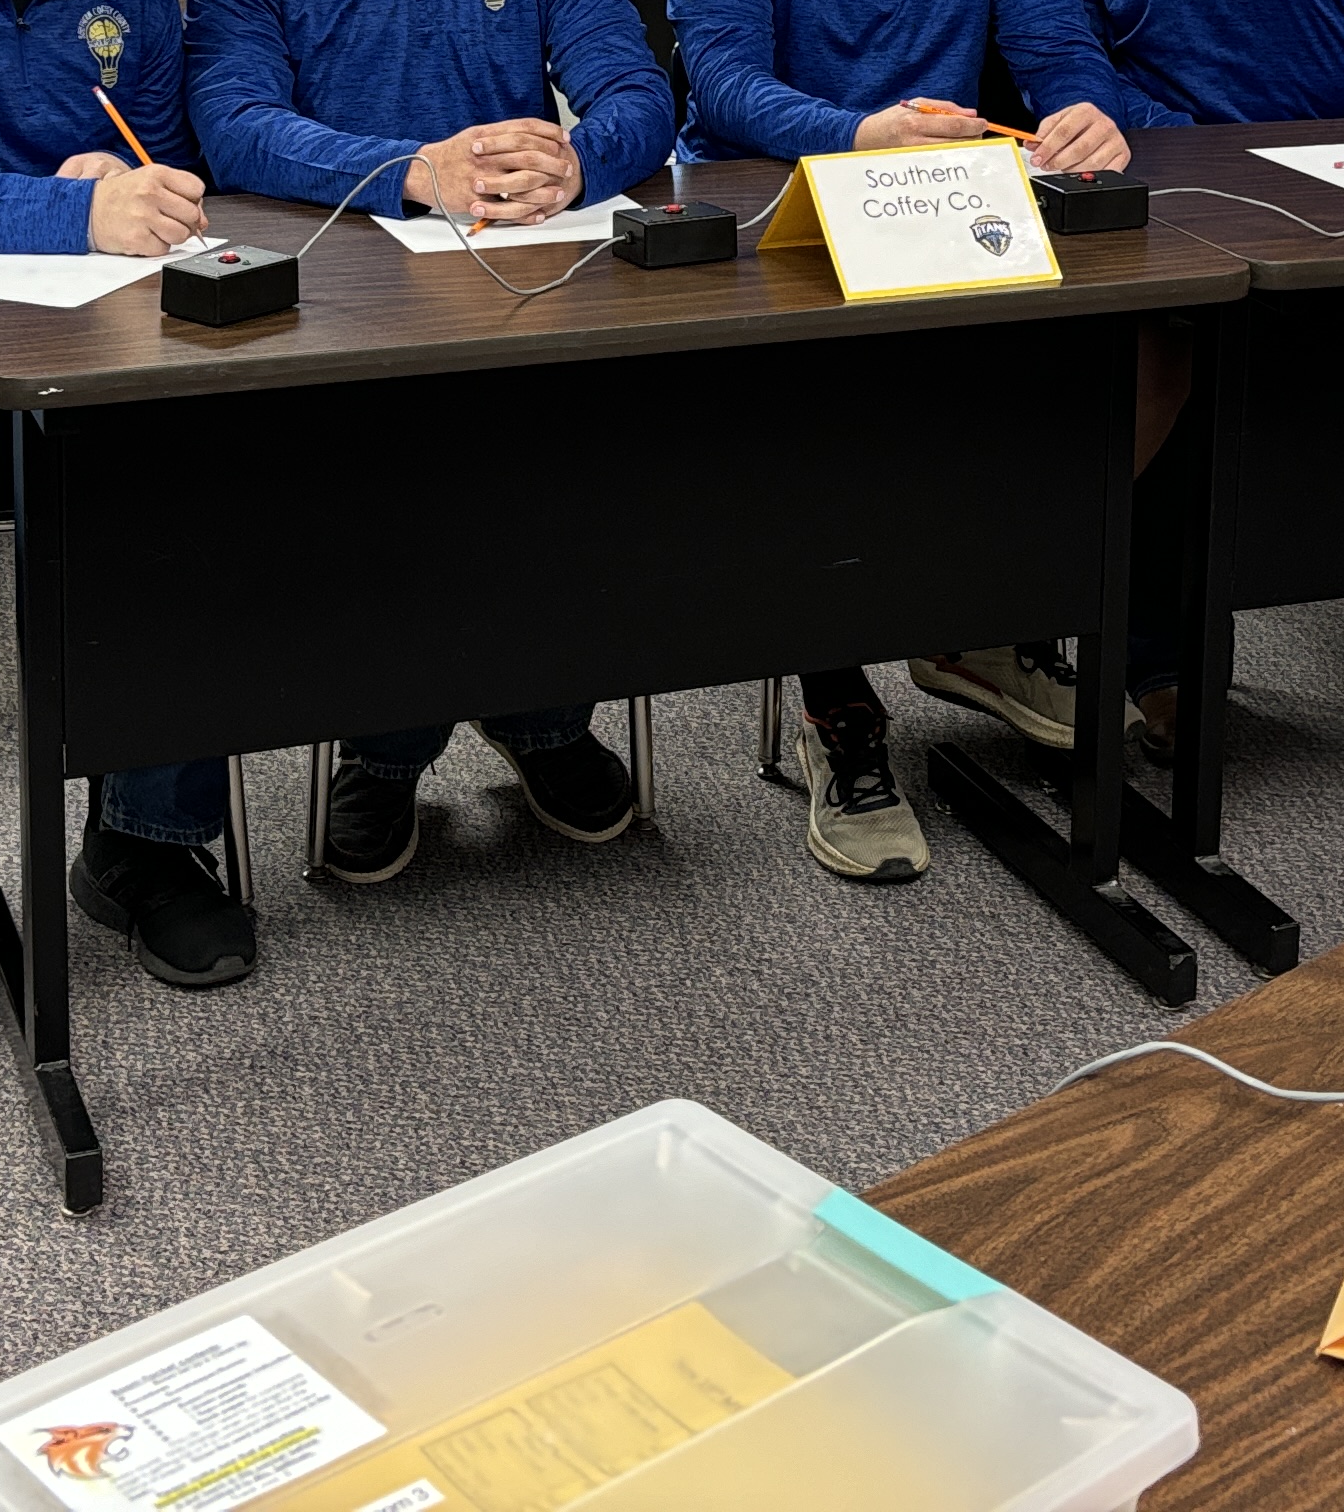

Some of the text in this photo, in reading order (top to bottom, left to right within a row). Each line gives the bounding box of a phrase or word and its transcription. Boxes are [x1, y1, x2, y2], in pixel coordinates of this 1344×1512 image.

[865, 165, 970, 189] Southern
[863, 191, 991, 219] Coffey Co.
[971, 222, 1011, 238] TITANS
